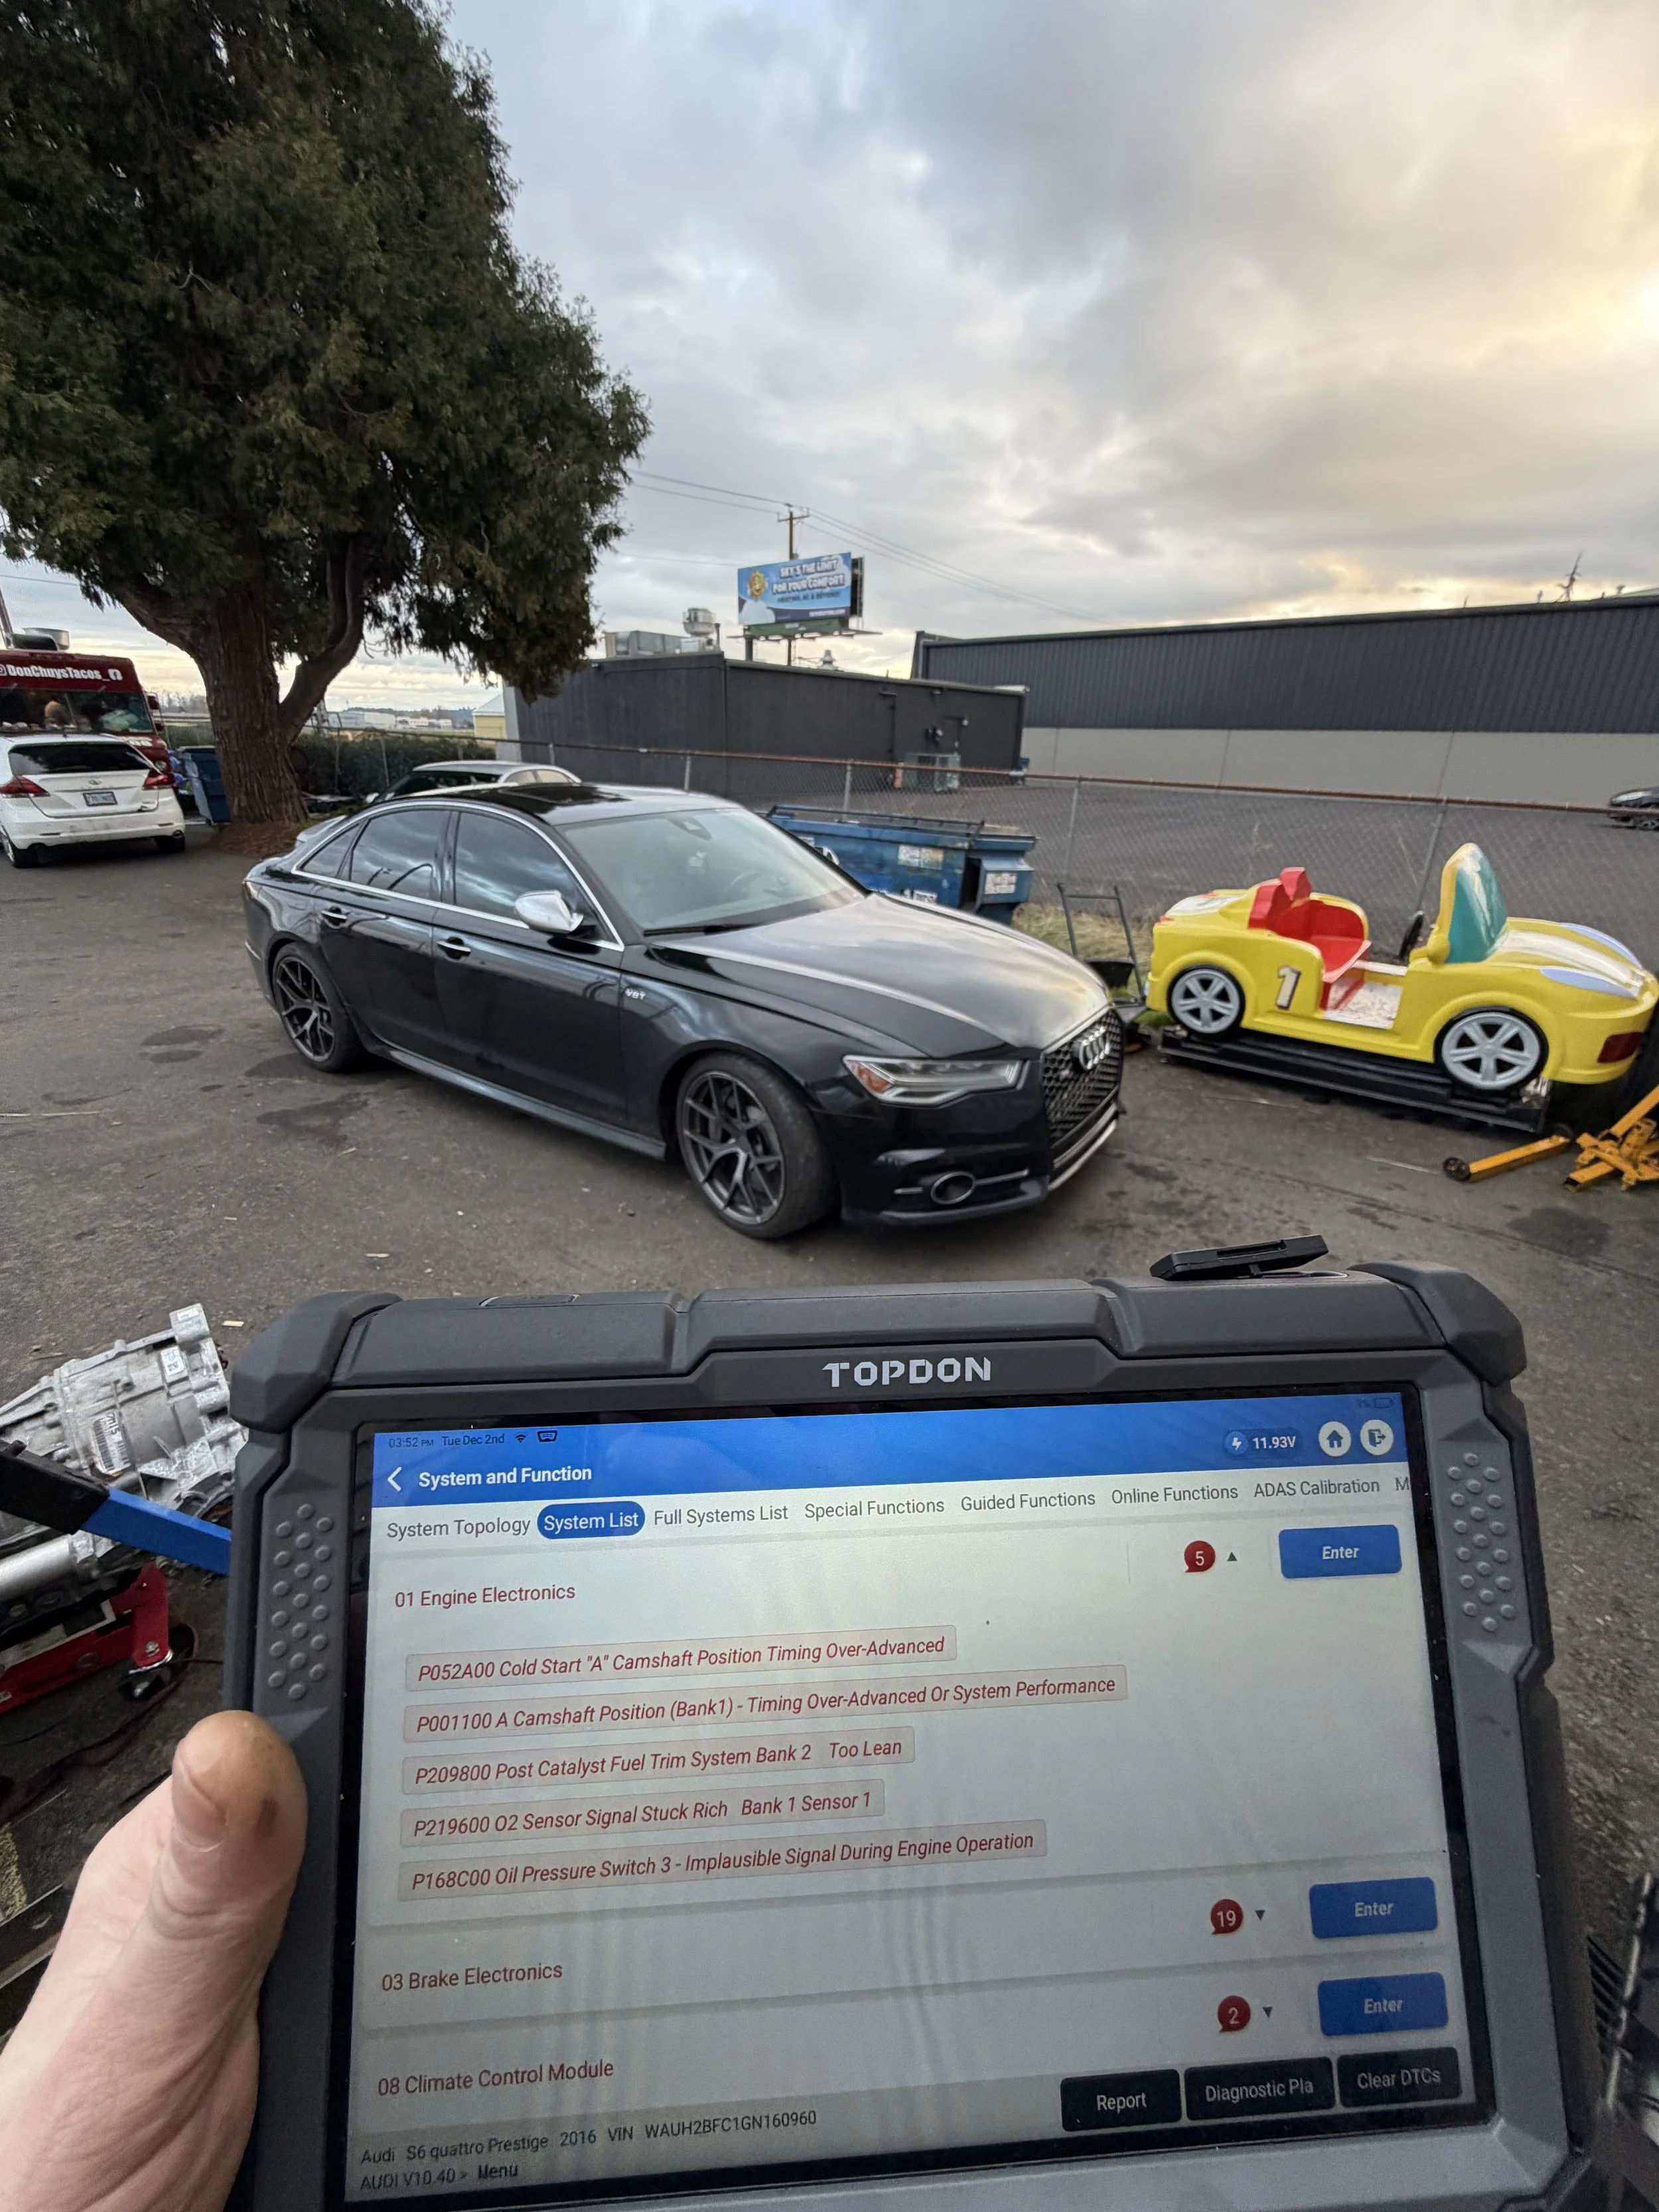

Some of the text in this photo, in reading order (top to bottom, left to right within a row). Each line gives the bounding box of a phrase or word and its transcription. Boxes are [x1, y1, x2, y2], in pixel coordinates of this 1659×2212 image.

[1275, 964, 1301, 1010] 1
[822, 1357, 991, 1388] TOPDON
[389, 1438, 418, 1448] 03:52
[442, 1436, 460, 1445] Tue
[463, 1435, 482, 1445] Dec
[485, 1434, 504, 1444] 2nd
[1253, 1436, 1295, 1449] 11.93V
[419, 1466, 591, 1491] System and Function
[1254, 1479, 1380, 1497] ADAS Calibration
[962, 1494, 1095, 1511] Guided Functions
[1112, 1486, 1238, 1504] Online Functions
[655, 1506, 788, 1527] Full Systems List
[805, 1501, 944, 1521] Special Functions
[388, 1517, 530, 1541] System Topology
[545, 1512, 638, 1533] System List
[1196, 1551, 1204, 1566] 5
[1323, 1546, 1359, 1559] Enter
[396, 1584, 575, 1609] 01 Engine Electronics
[419, 1637, 944, 1681] P052A00 Cold Start "A" Camshaft Position Timing Over-Advanced
[417, 1713, 492, 1732] P001100
[496, 1712, 508, 1728] A
[514, 1706, 595, 1727] Camshaft
[600, 1704, 665, 1721] Position
[671, 1698, 733, 1721] (Bank1)
[748, 1696, 802, 1714] Timing
[808, 1686, 926, 1709] Over-Advanced
[931, 1686, 950, 1702] Or
[954, 1685, 1011, 1704] System
[1016, 1679, 1115, 1696] Performance
[415, 1741, 901, 1784] P209800 Post Catalyst Fuel Trim System Bank 2 Too Lean
[414, 1792, 869, 1836] P219600 O2 Sensor Signal Stuck Rich Bank 1 Sensor 1
[413, 1869, 490, 1890] P168C00
[496, 1866, 518, 1884] Oil
[522, 1866, 595, 1882] Pressure
[600, 1857, 656, 1877] Switch
[661, 1856, 671, 1873] 3
[685, 1849, 780, 1874] Implausible
[785, 1844, 836, 1868] Signal
[841, 1844, 893, 1862] During
[898, 1840, 952, 1860] Engine
[956, 1833, 1033, 1856] Operation
[1218, 1910, 1236, 1926] 19
[1355, 1902, 1394, 1917] Enter
[382, 1963, 562, 1991] 03 Brake Electronics
[1228, 2008, 1238, 2024] 2
[1364, 1998, 1403, 2014] Enter
[378, 2059, 613, 2096] 08 Climate Control Module
[1358, 2068, 1441, 2089] Clear DTCs
[1206, 2078, 1313, 2103] Diagnostic Pla
[1097, 2093, 1147, 2113] Report
[361, 2148, 394, 2165] Audi
[407, 2145, 425, 2161] S6
[429, 2142, 484, 2161] quattro
[488, 2137, 548, 2152] Prestige
[561, 2130, 596, 2146] 2016
[608, 2126, 633, 2142] VIN
[360, 2174, 398, 2189] AUDI
